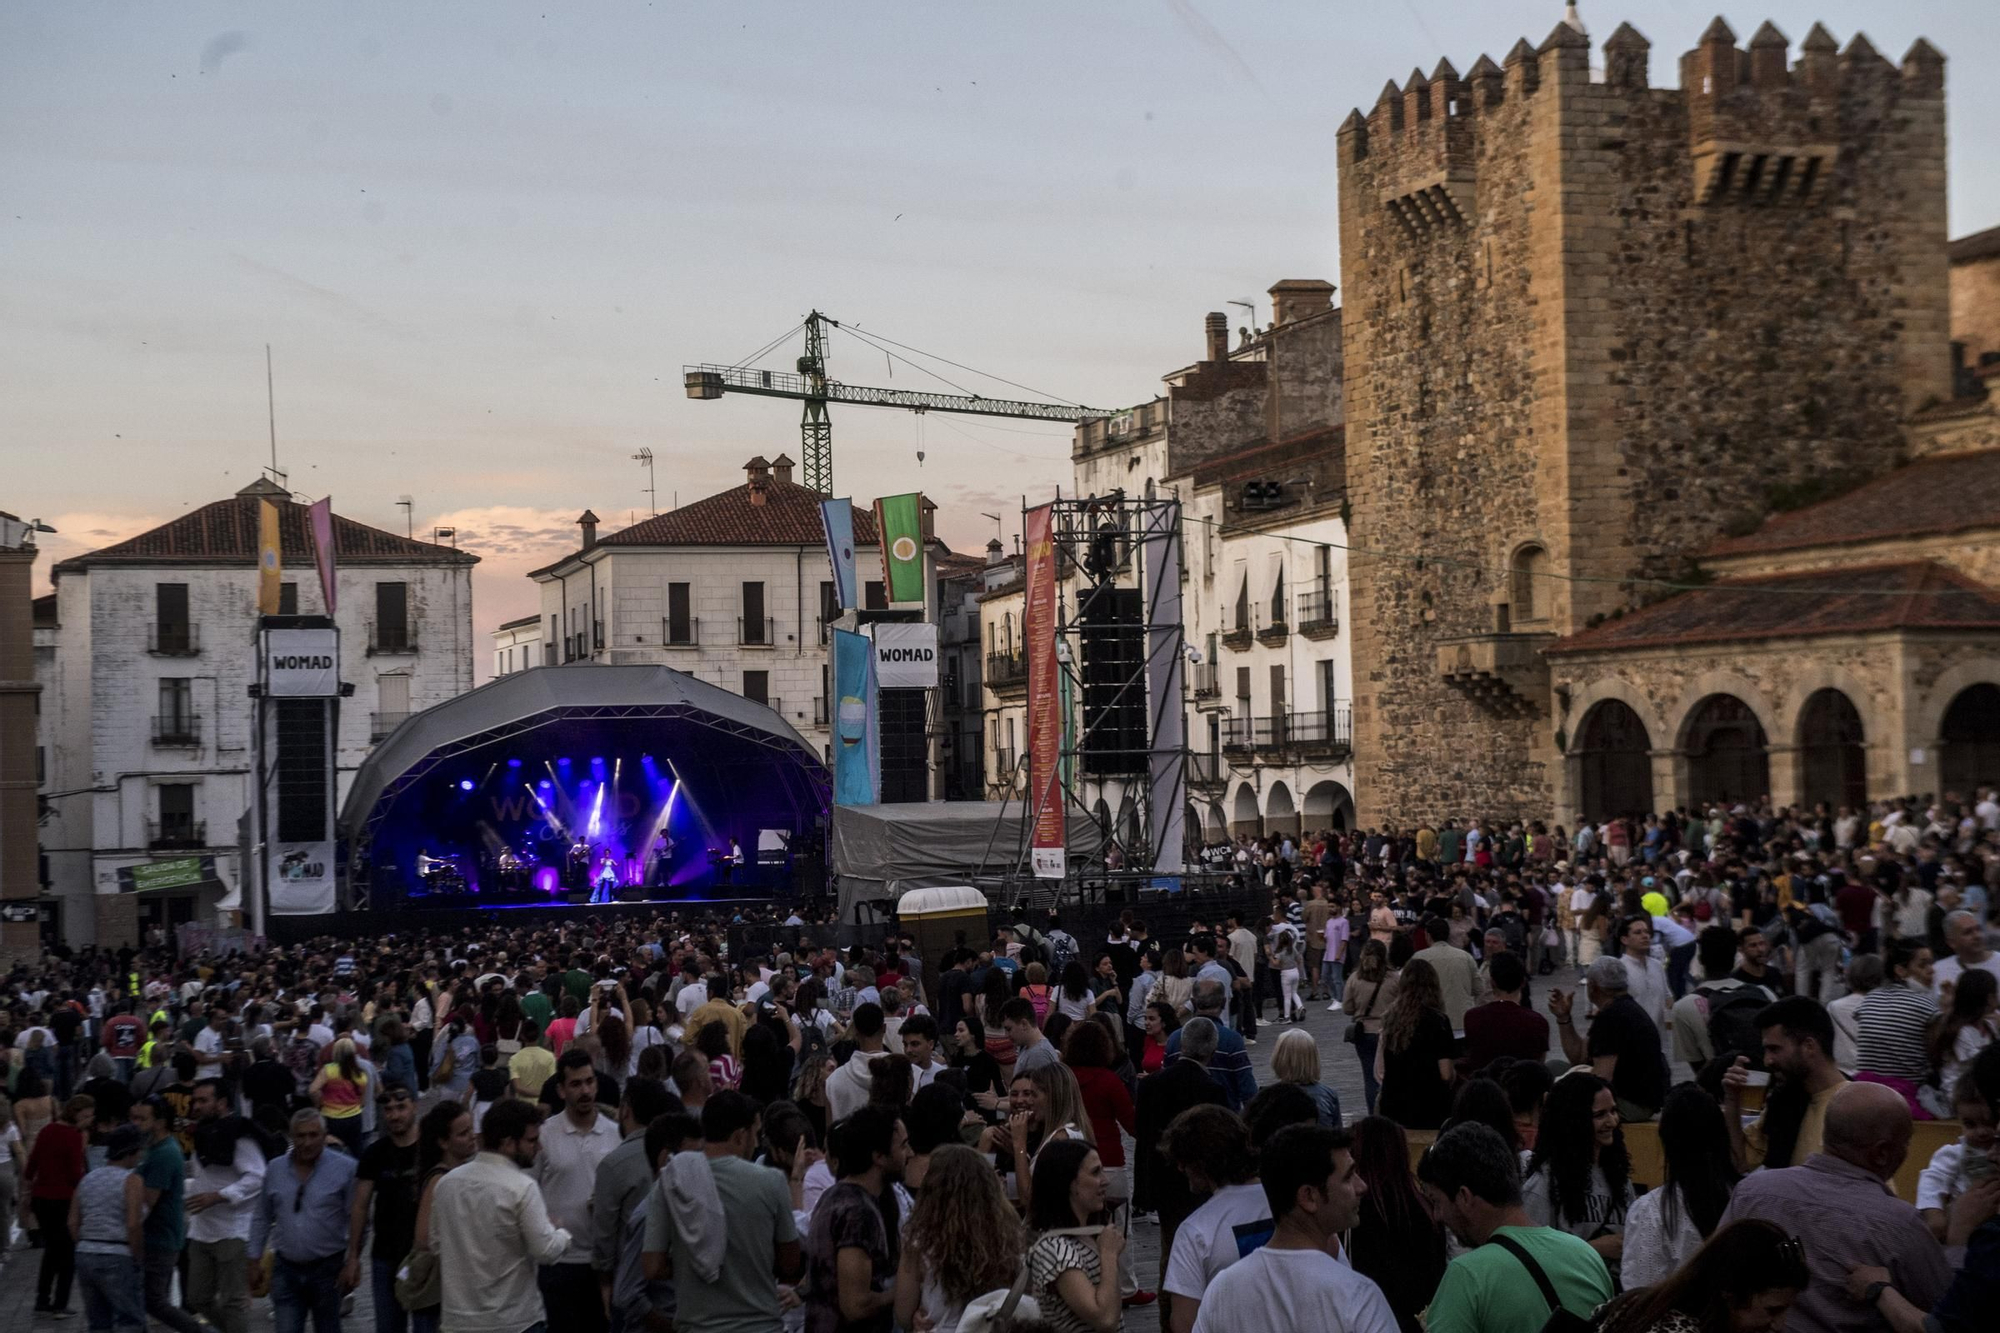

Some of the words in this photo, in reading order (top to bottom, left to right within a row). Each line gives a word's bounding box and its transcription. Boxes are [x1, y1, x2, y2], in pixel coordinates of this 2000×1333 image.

[273, 655, 333, 670] WOMAD
[879, 648, 933, 662] WOMAD
[490, 791, 641, 821] WOD
[1210, 846, 1227, 856] WC
[141, 862, 175, 874] SALIDA
[176, 859, 191, 869] DE
[135, 873, 200, 889] EMERGENCIA
